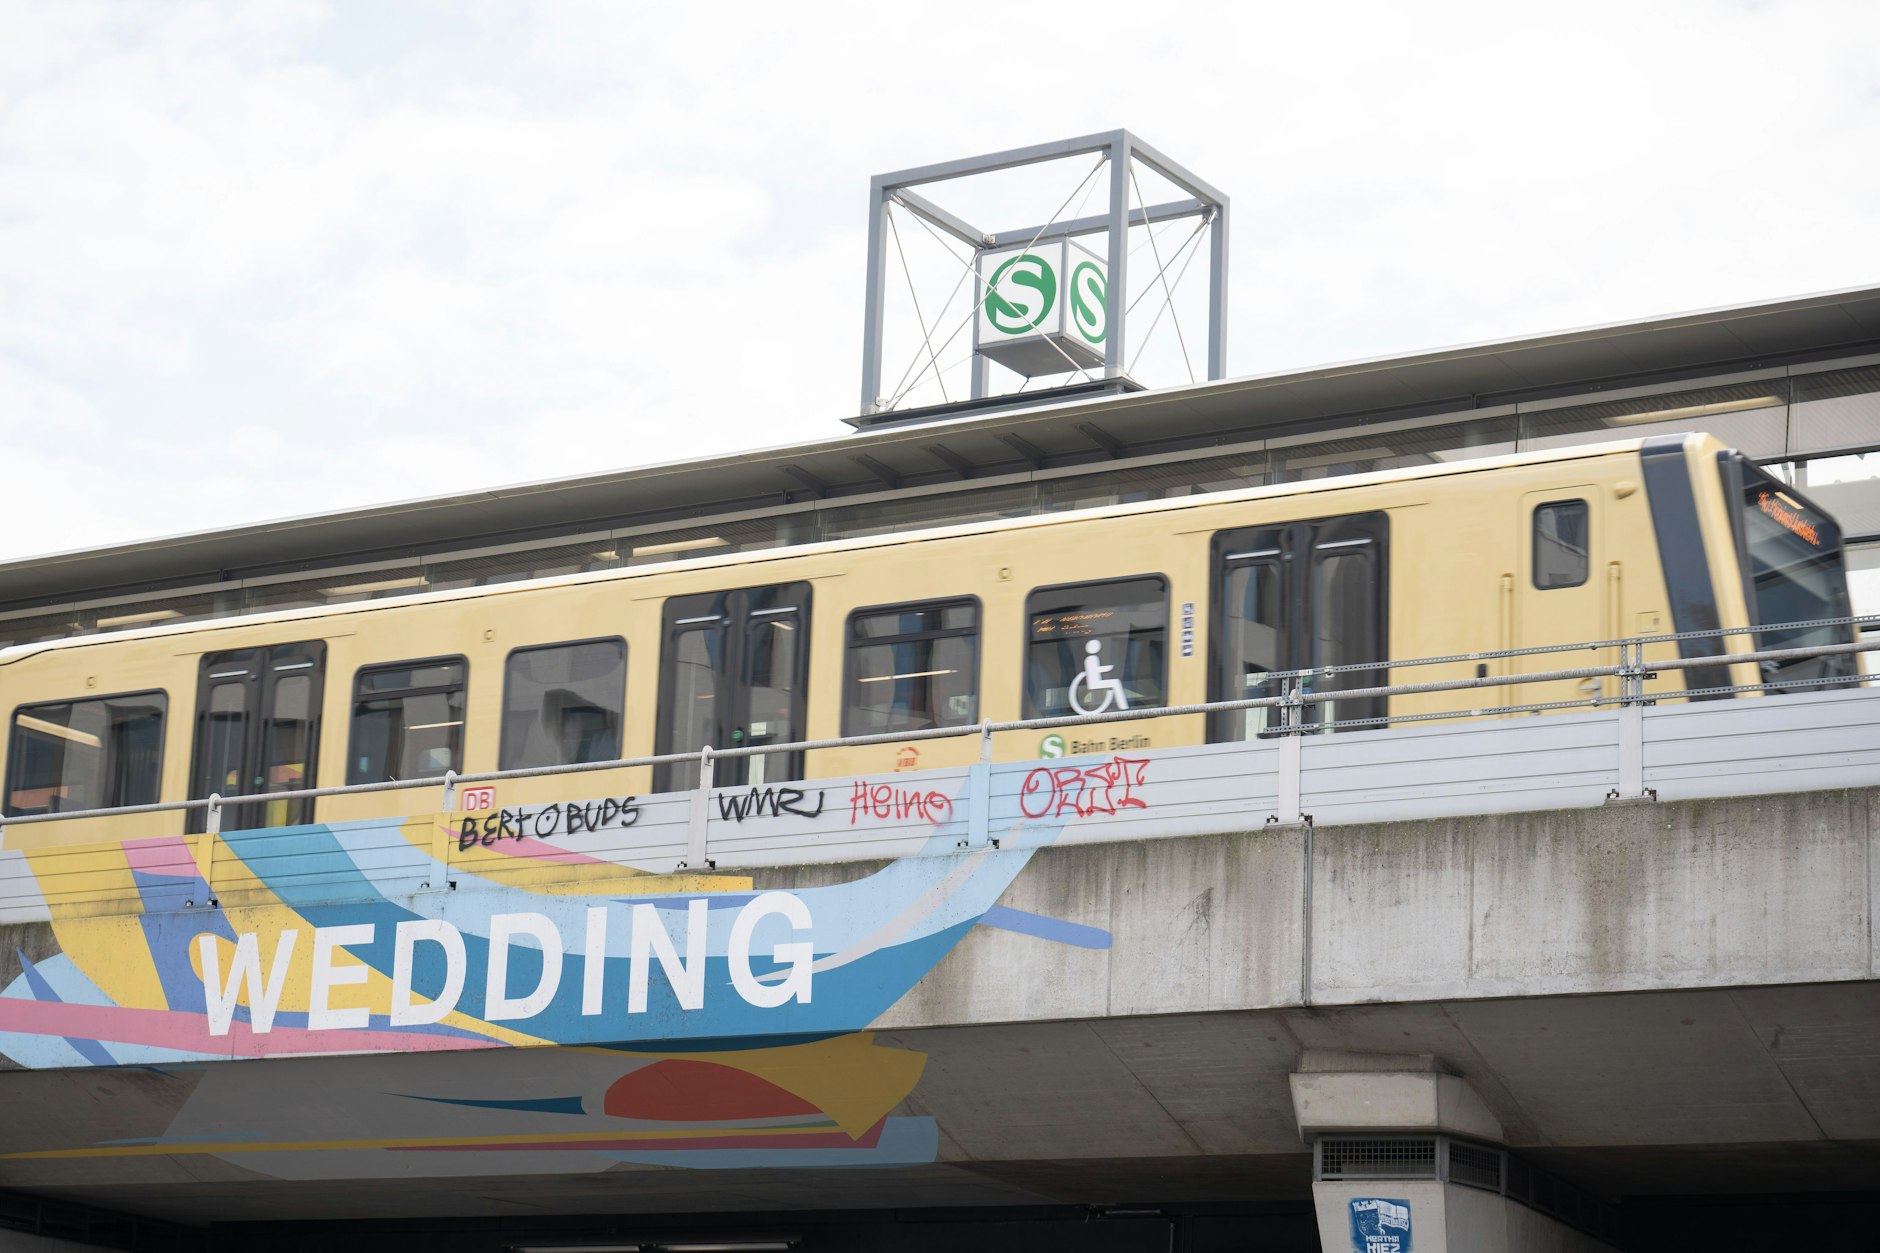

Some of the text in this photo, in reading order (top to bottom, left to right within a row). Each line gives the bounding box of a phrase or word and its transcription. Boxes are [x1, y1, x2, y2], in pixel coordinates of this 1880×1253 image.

[994, 260, 1046, 329] S
[1076, 267, 1107, 338] S
[1041, 735, 1150, 759] S Bahn Berlin
[466, 791, 490, 810] DB
[198, 891, 814, 1037] WEDDING
